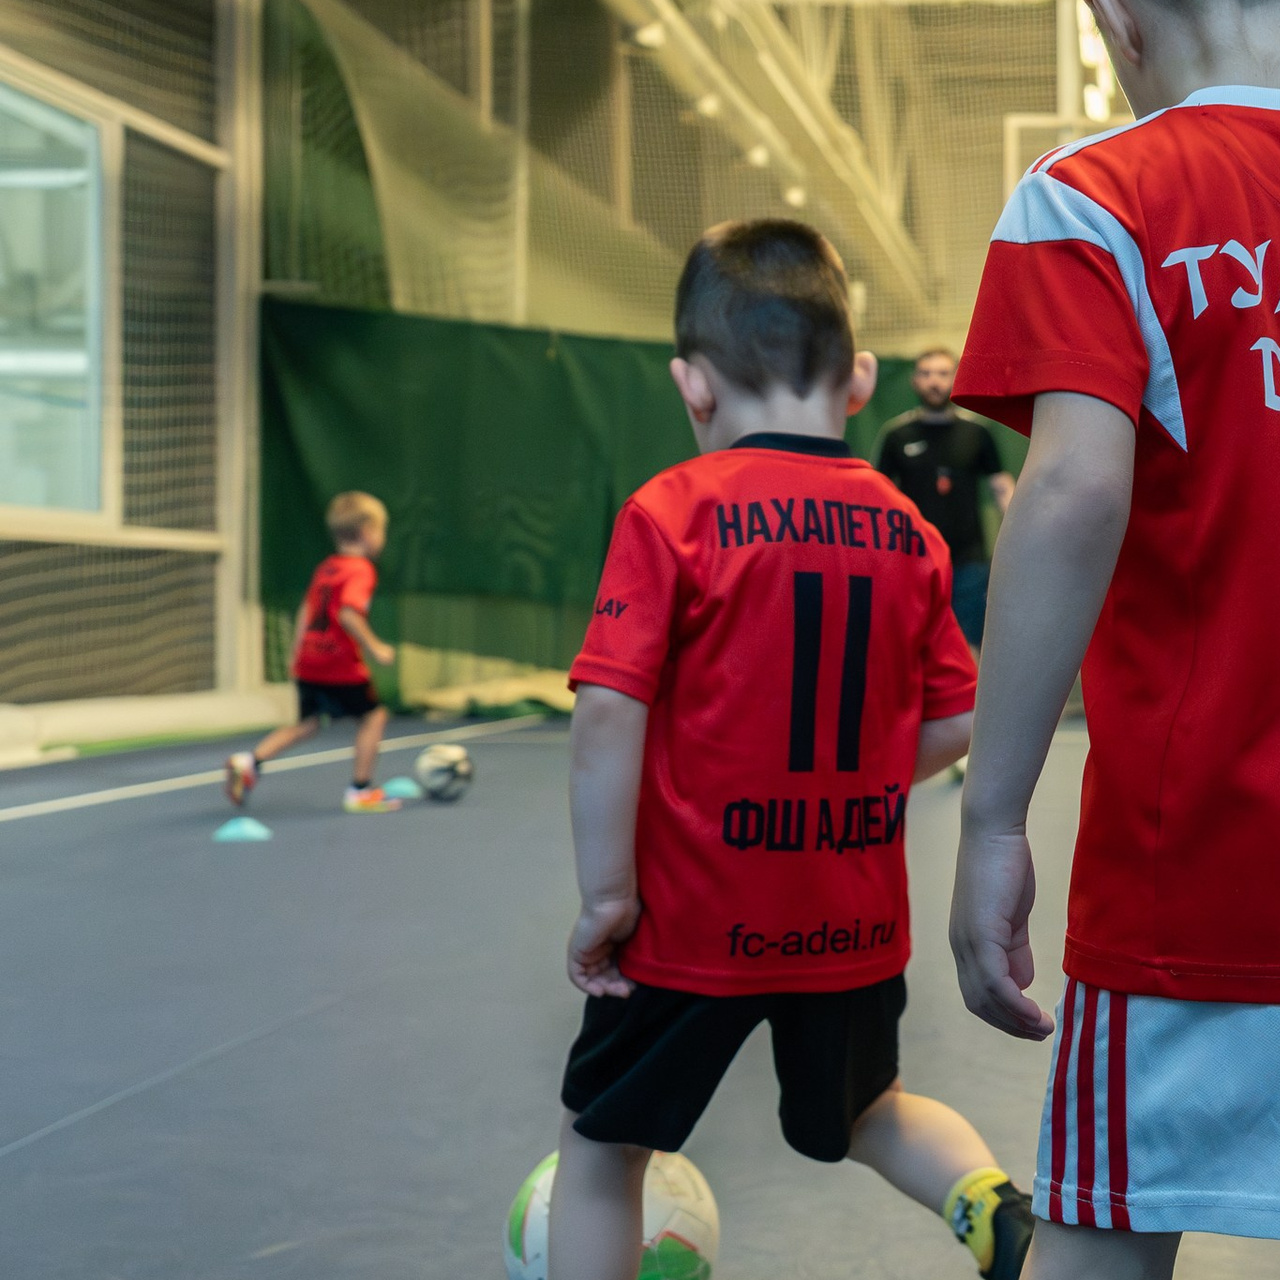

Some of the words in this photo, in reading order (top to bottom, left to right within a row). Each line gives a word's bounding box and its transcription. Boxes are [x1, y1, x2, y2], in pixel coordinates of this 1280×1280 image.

[787, 570, 873, 773] 11
[722, 797, 806, 852] ФШ
[814, 782, 905, 855] АДЕЙ
[727, 918, 897, 958] fc-adei.ru
